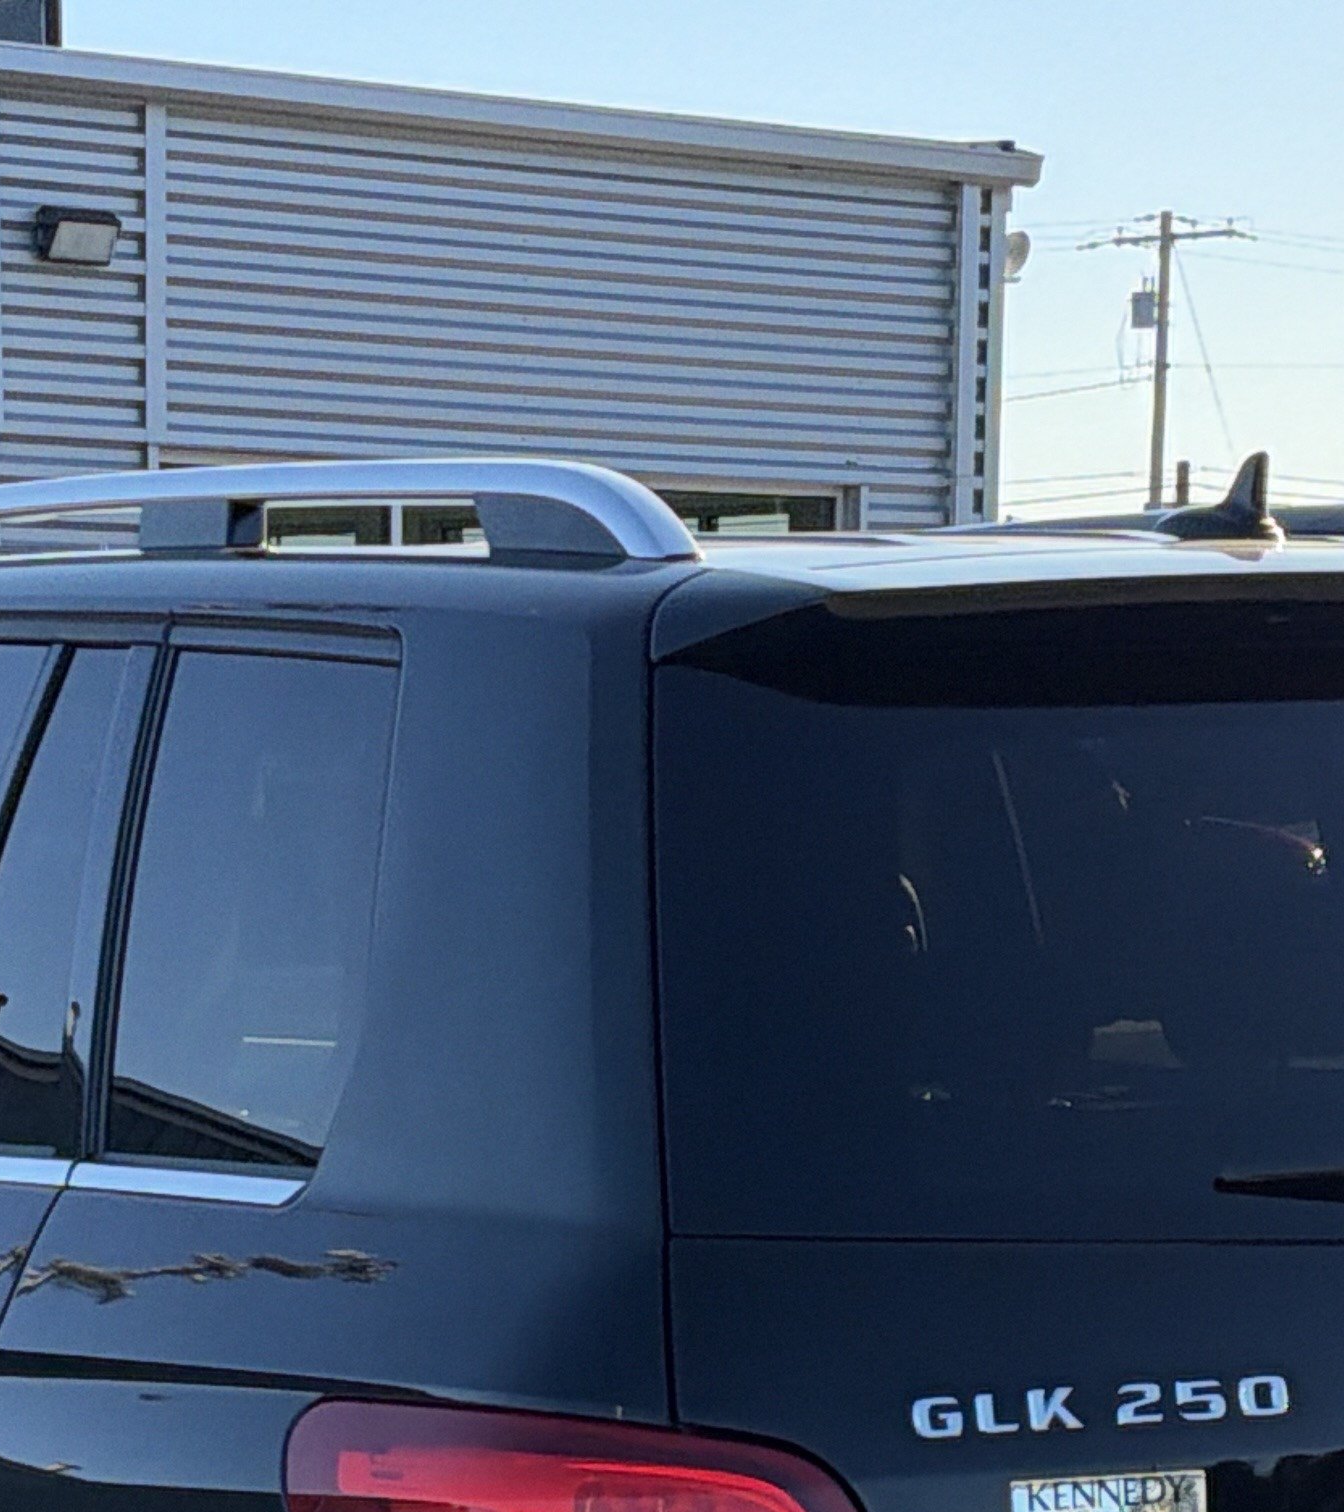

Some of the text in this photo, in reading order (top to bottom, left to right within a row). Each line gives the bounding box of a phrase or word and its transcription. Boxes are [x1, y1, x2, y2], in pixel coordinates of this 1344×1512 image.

[911, 1374, 1290, 1440] GLK 250
[1027, 1474, 1188, 1512] KENNEDY
